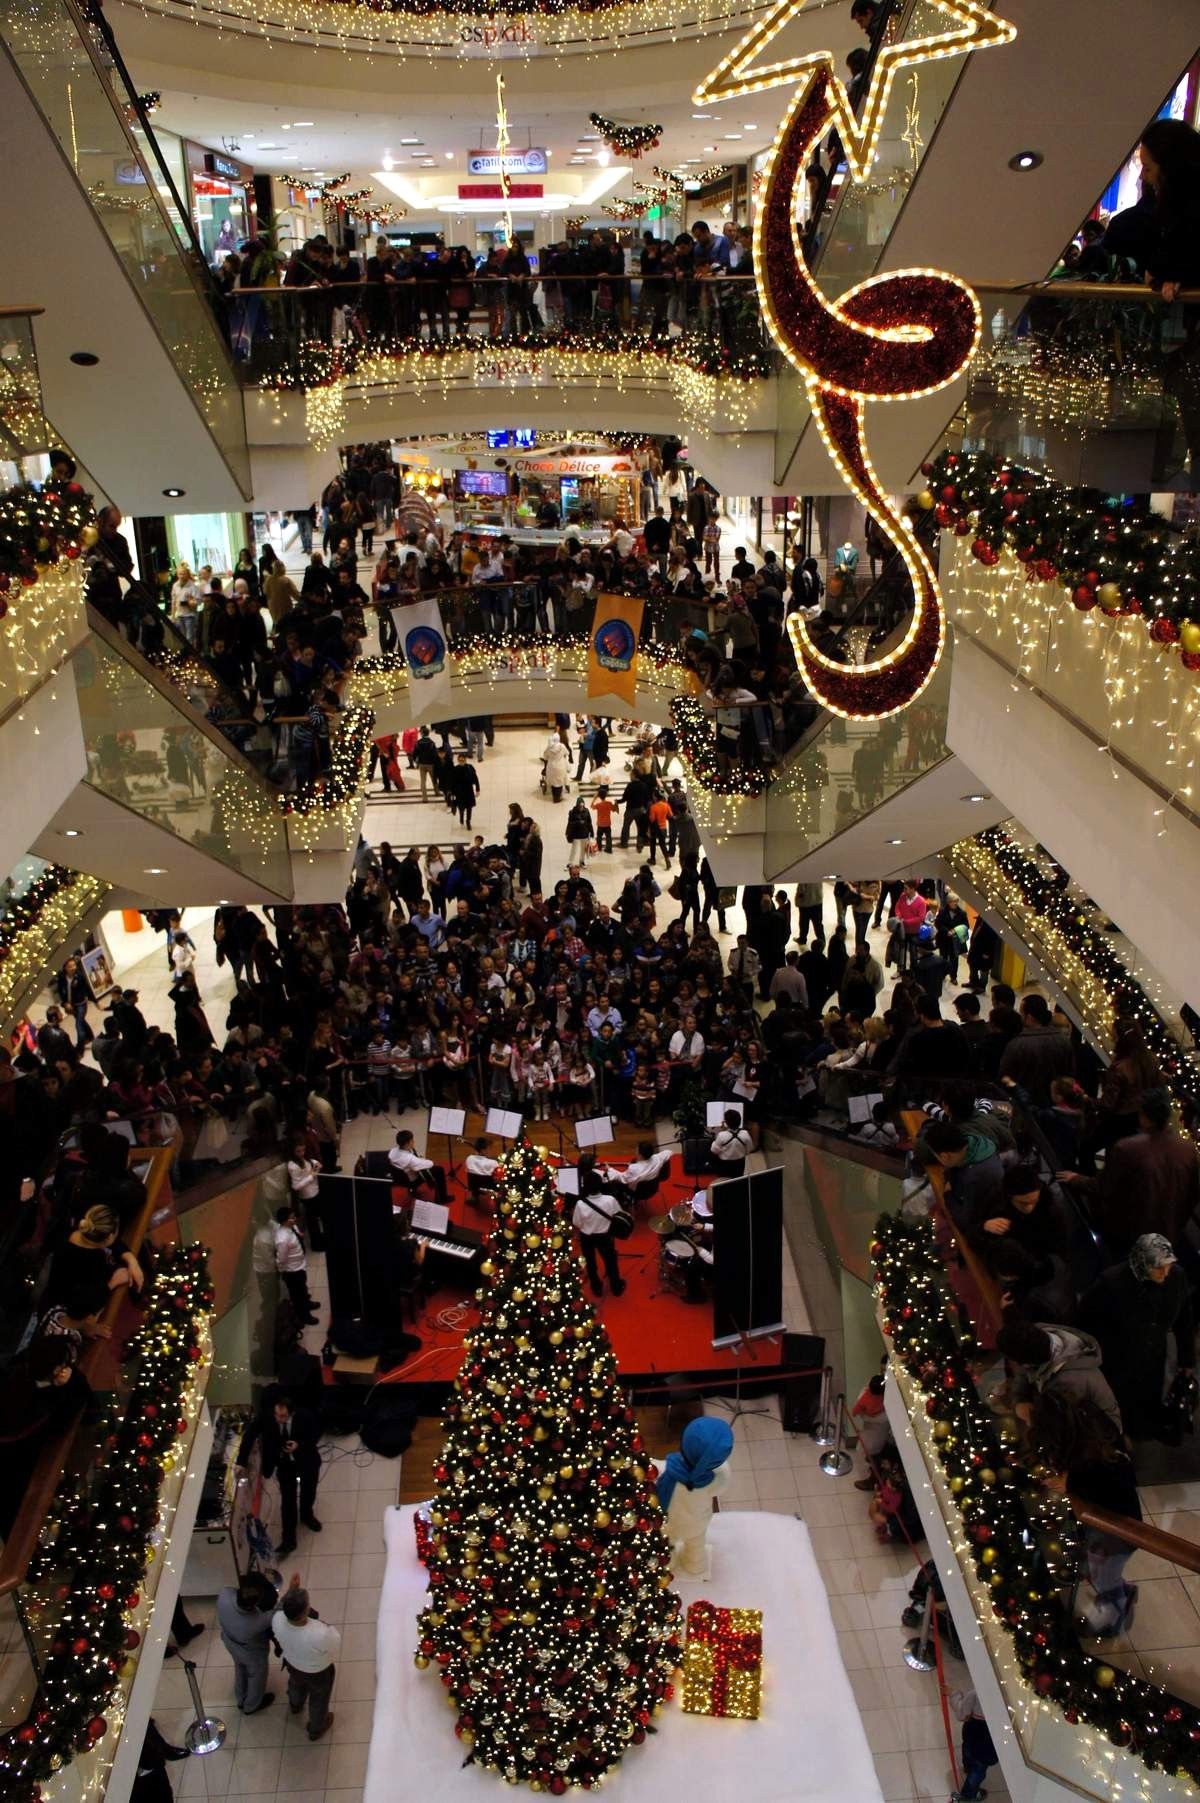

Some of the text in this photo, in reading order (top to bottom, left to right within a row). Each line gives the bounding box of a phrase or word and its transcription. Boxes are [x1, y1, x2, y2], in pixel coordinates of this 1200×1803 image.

[481, 157, 522, 168] tatilcom
[515, 459, 600, 472] Choco Délice
